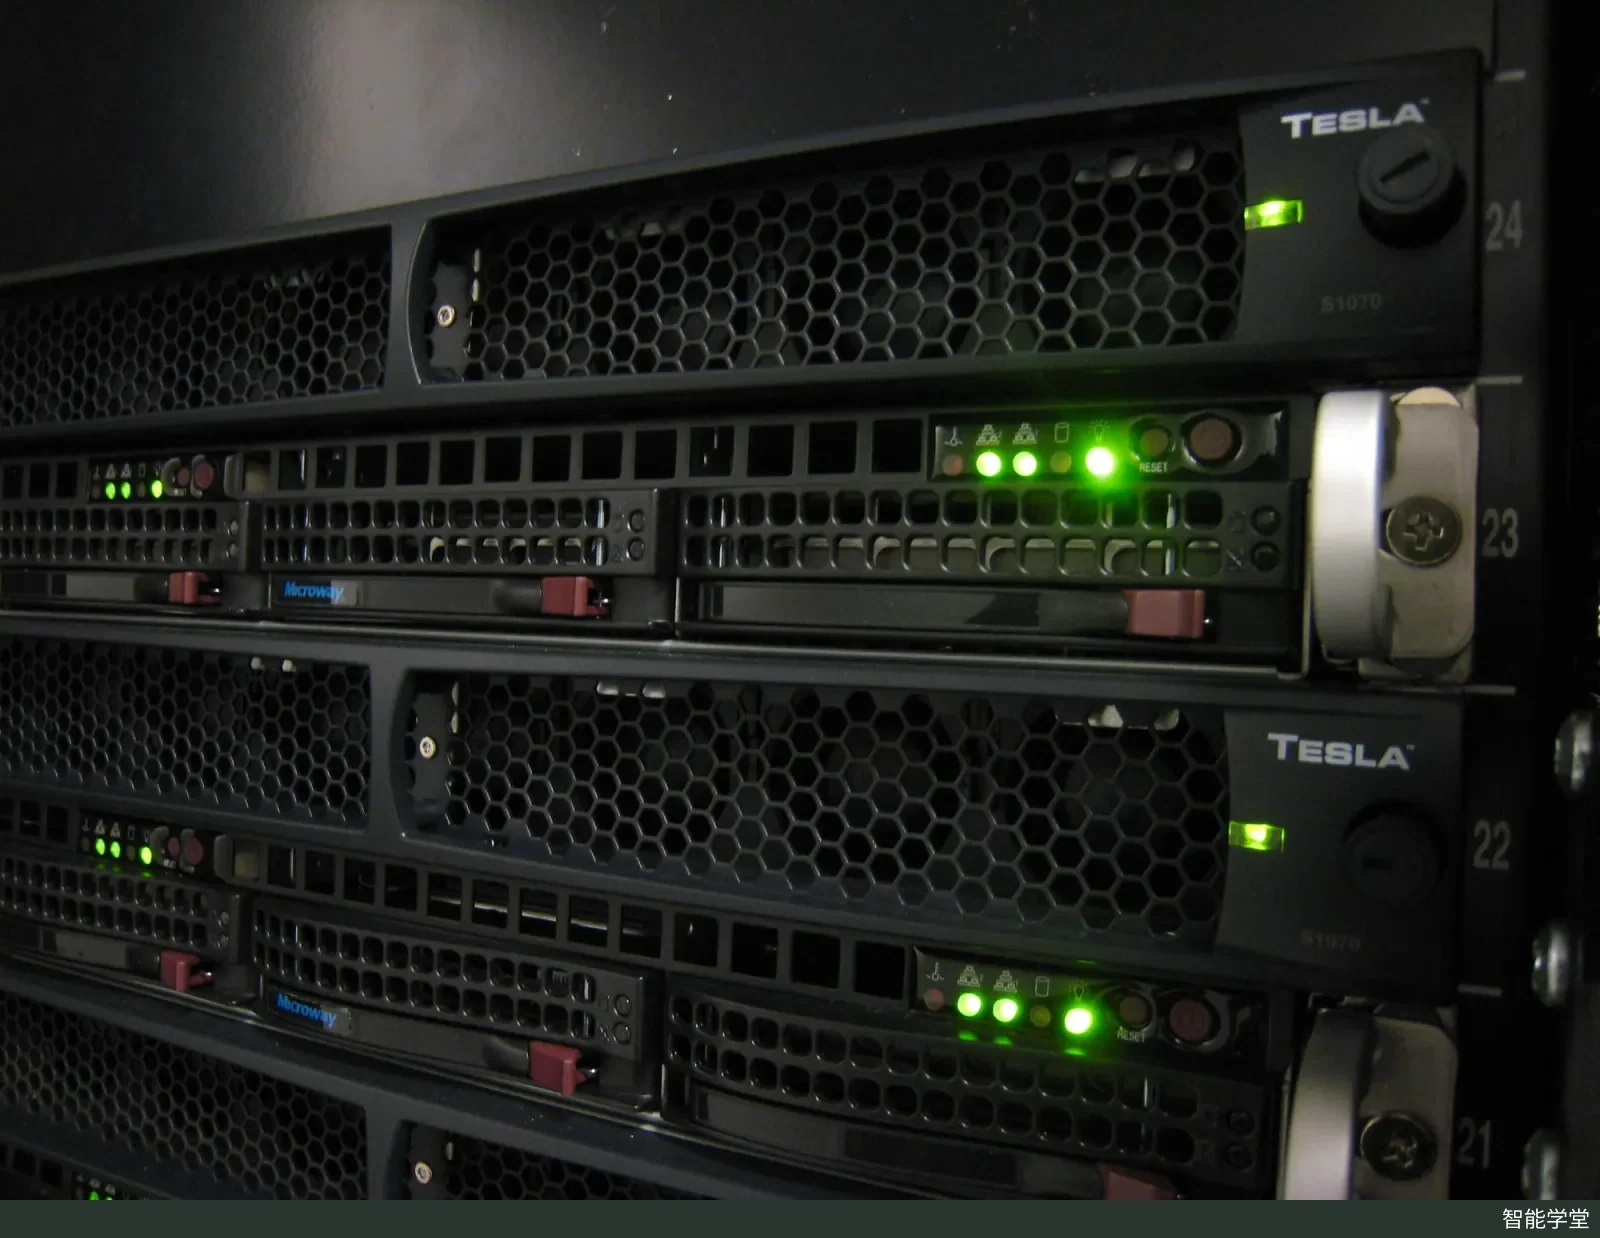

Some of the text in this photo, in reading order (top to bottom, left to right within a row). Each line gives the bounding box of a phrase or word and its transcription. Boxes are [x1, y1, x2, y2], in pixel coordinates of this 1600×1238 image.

[1484, 200, 1524, 251] 24
[1138, 460, 1169, 474] RESET
[1481, 507, 1520, 559] 23
[283, 580, 345, 602] Microway
[1472, 817, 1512, 871] 22
[275, 992, 338, 1027] Microway
[1116, 1026, 1147, 1044] RESET
[1455, 1116, 1493, 1170] 21
